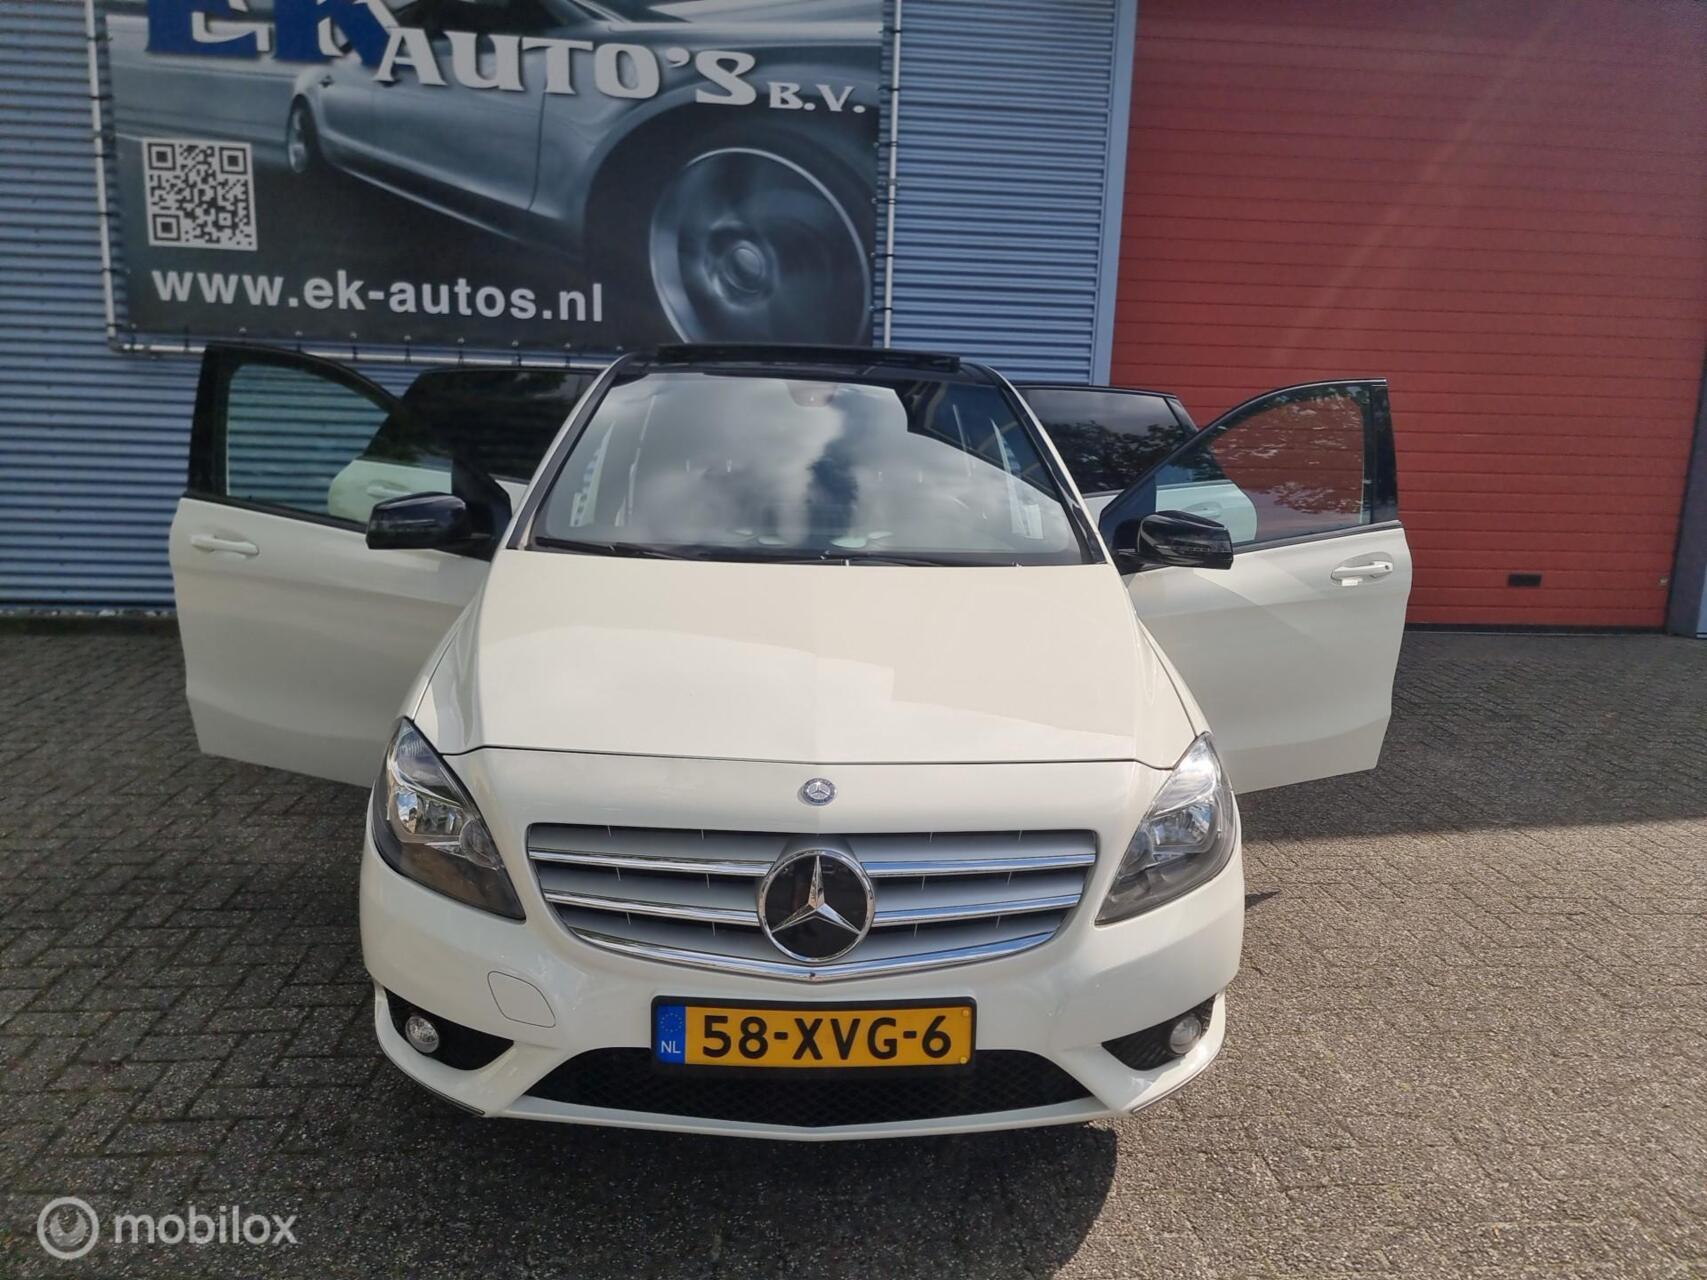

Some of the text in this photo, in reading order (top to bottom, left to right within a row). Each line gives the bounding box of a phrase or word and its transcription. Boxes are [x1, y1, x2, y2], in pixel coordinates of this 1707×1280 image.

[373, 27, 757, 106] AUTO'S
[767, 81, 867, 113] B.V.
[151, 269, 603, 322] www.ek-autos.nl
[660, 1040, 681, 1054] NL
[702, 1014, 952, 1060] 58-XVG-6
